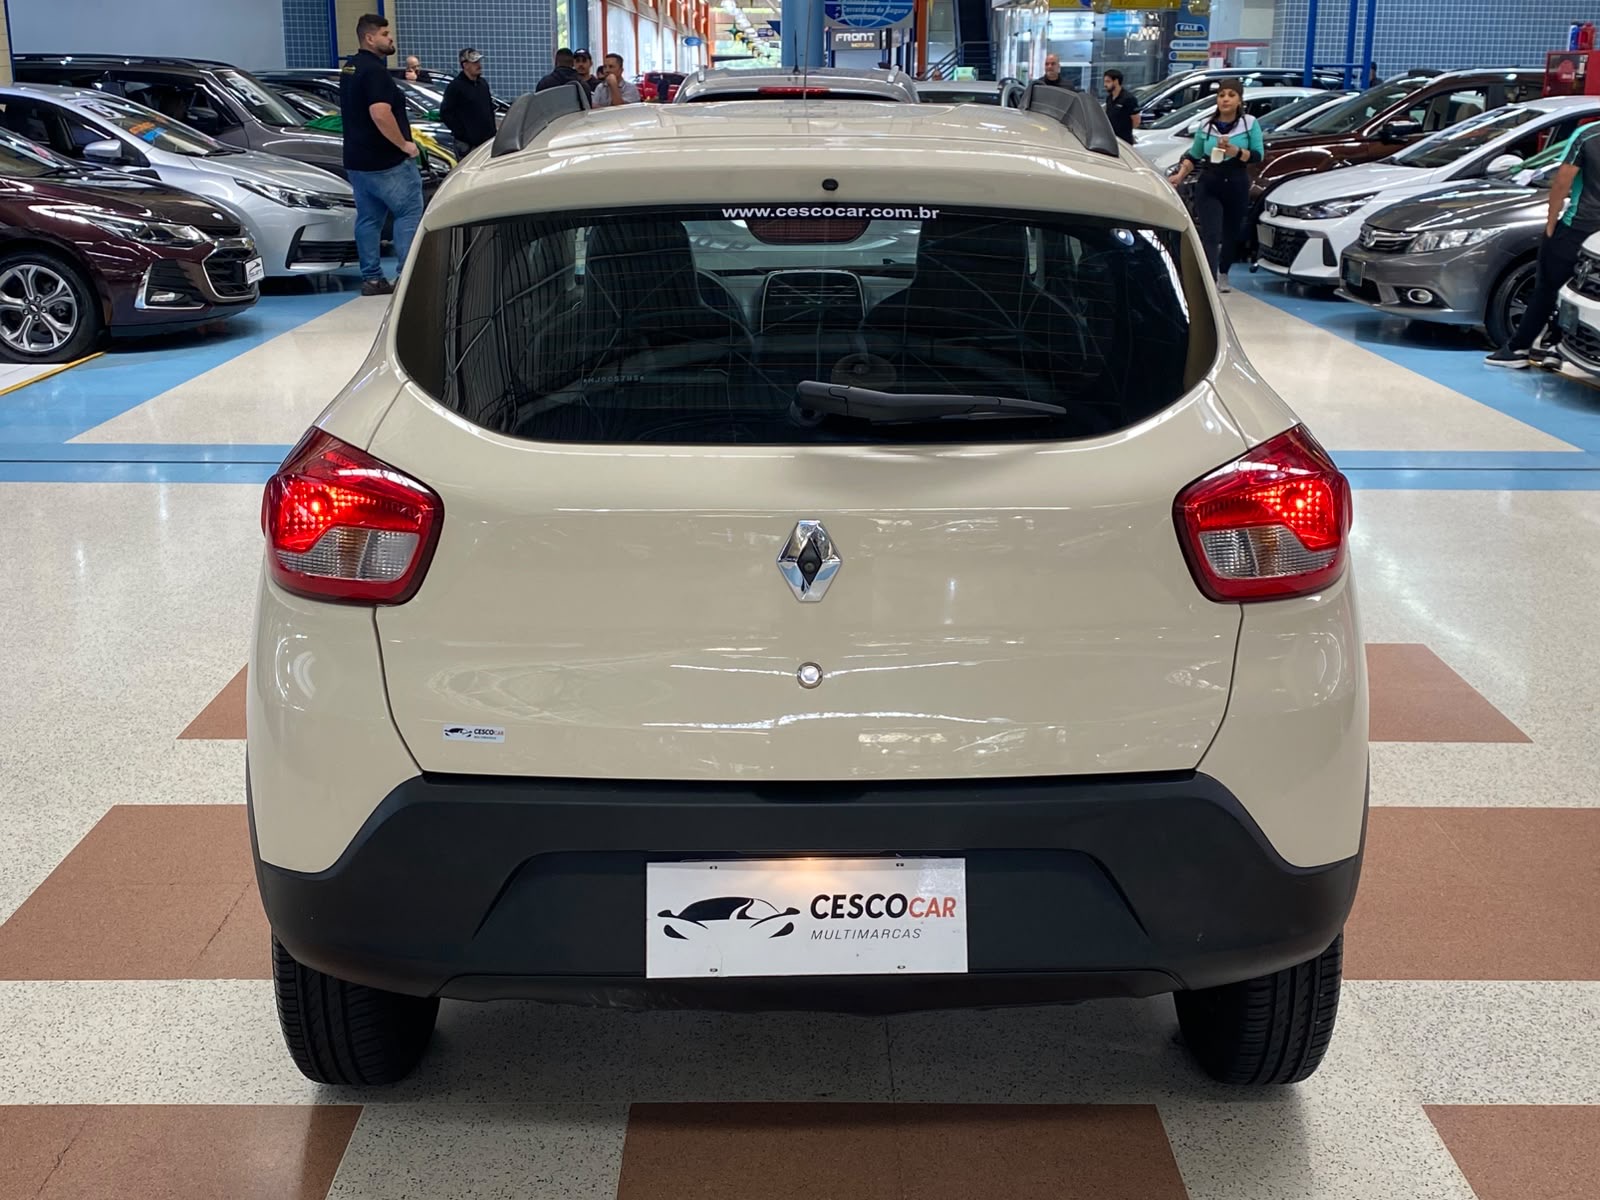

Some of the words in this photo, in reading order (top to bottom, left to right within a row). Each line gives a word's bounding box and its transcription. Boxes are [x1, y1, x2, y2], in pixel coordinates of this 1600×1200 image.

[835, 33, 875, 42] FRONT
[722, 206, 940, 219] www.cescocar.com.br
[474, 728, 504, 736] CESCOCAR
[810, 893, 957, 919] CESCOCAR
[810, 928, 922, 940] MULTIMARCAS
